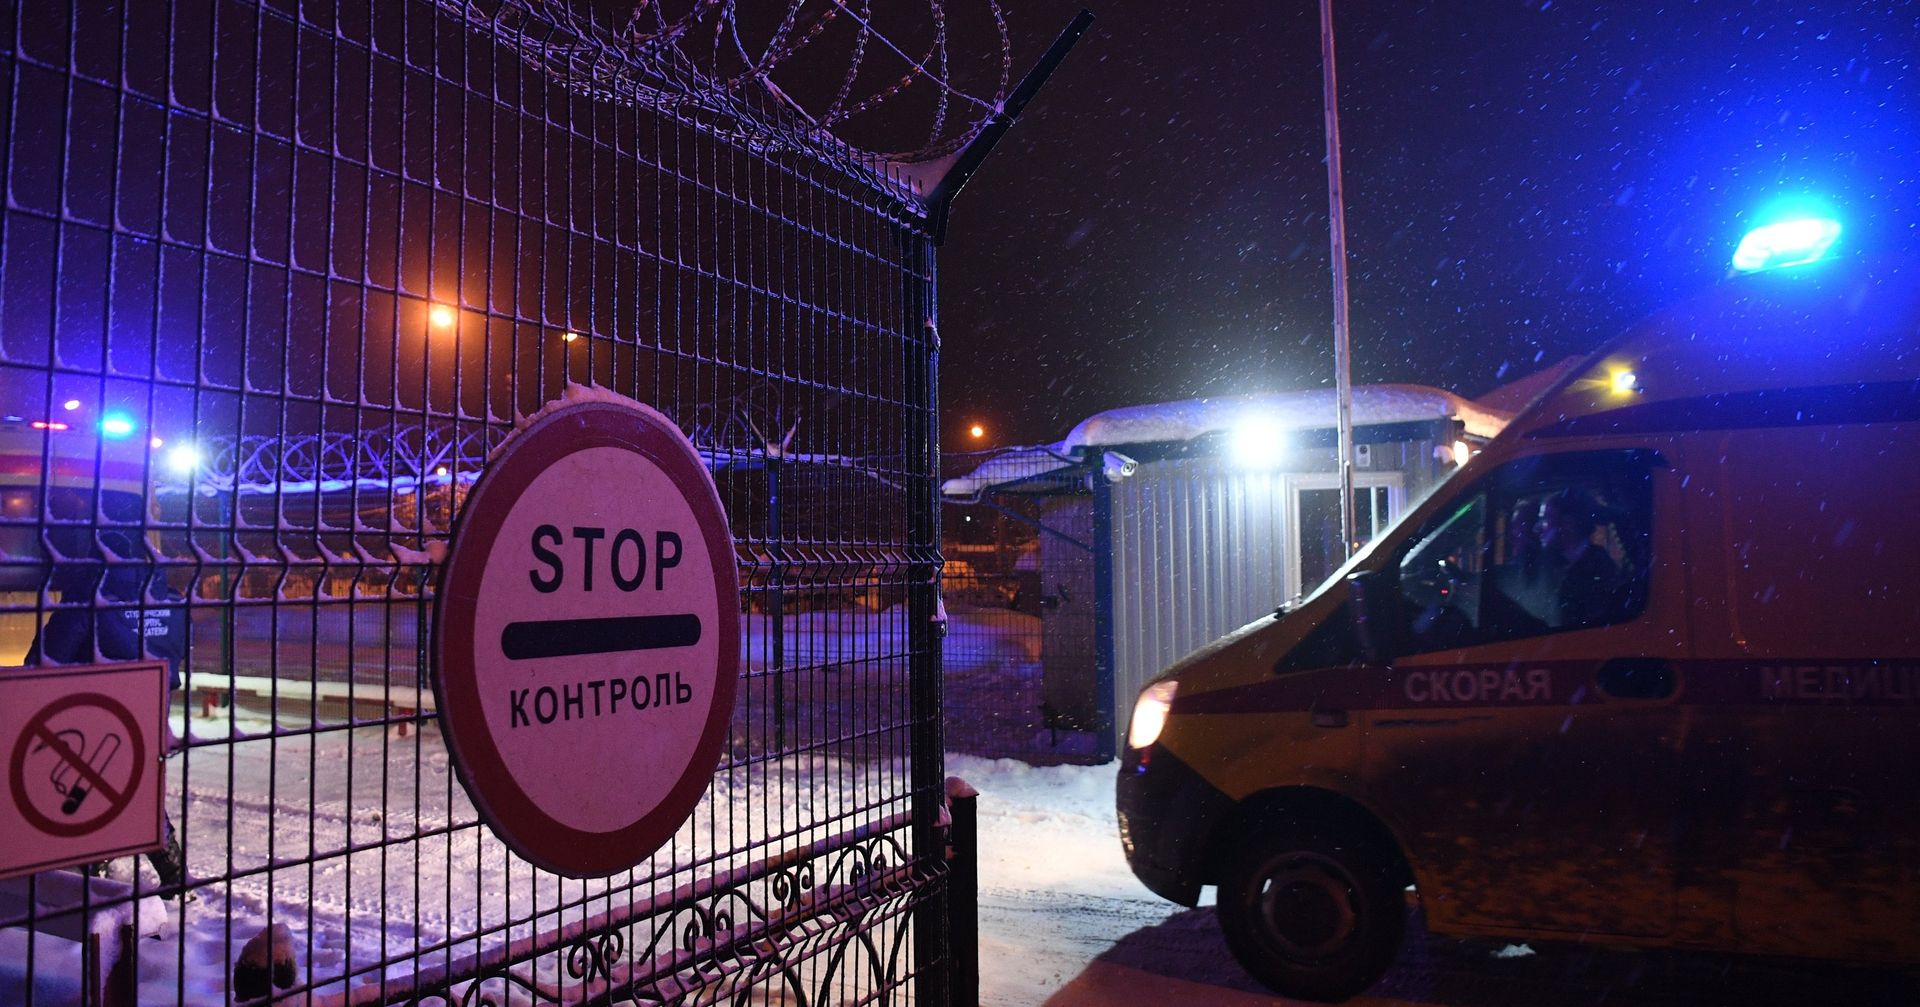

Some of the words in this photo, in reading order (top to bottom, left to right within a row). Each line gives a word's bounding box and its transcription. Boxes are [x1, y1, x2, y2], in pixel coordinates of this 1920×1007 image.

[529, 524, 683, 593] STOP
[510, 671, 692, 728] КОНТРОЛЬ
[1405, 669, 1551, 702] СКОРАЯ
[1760, 665, 1920, 703] МЕДИЦ
